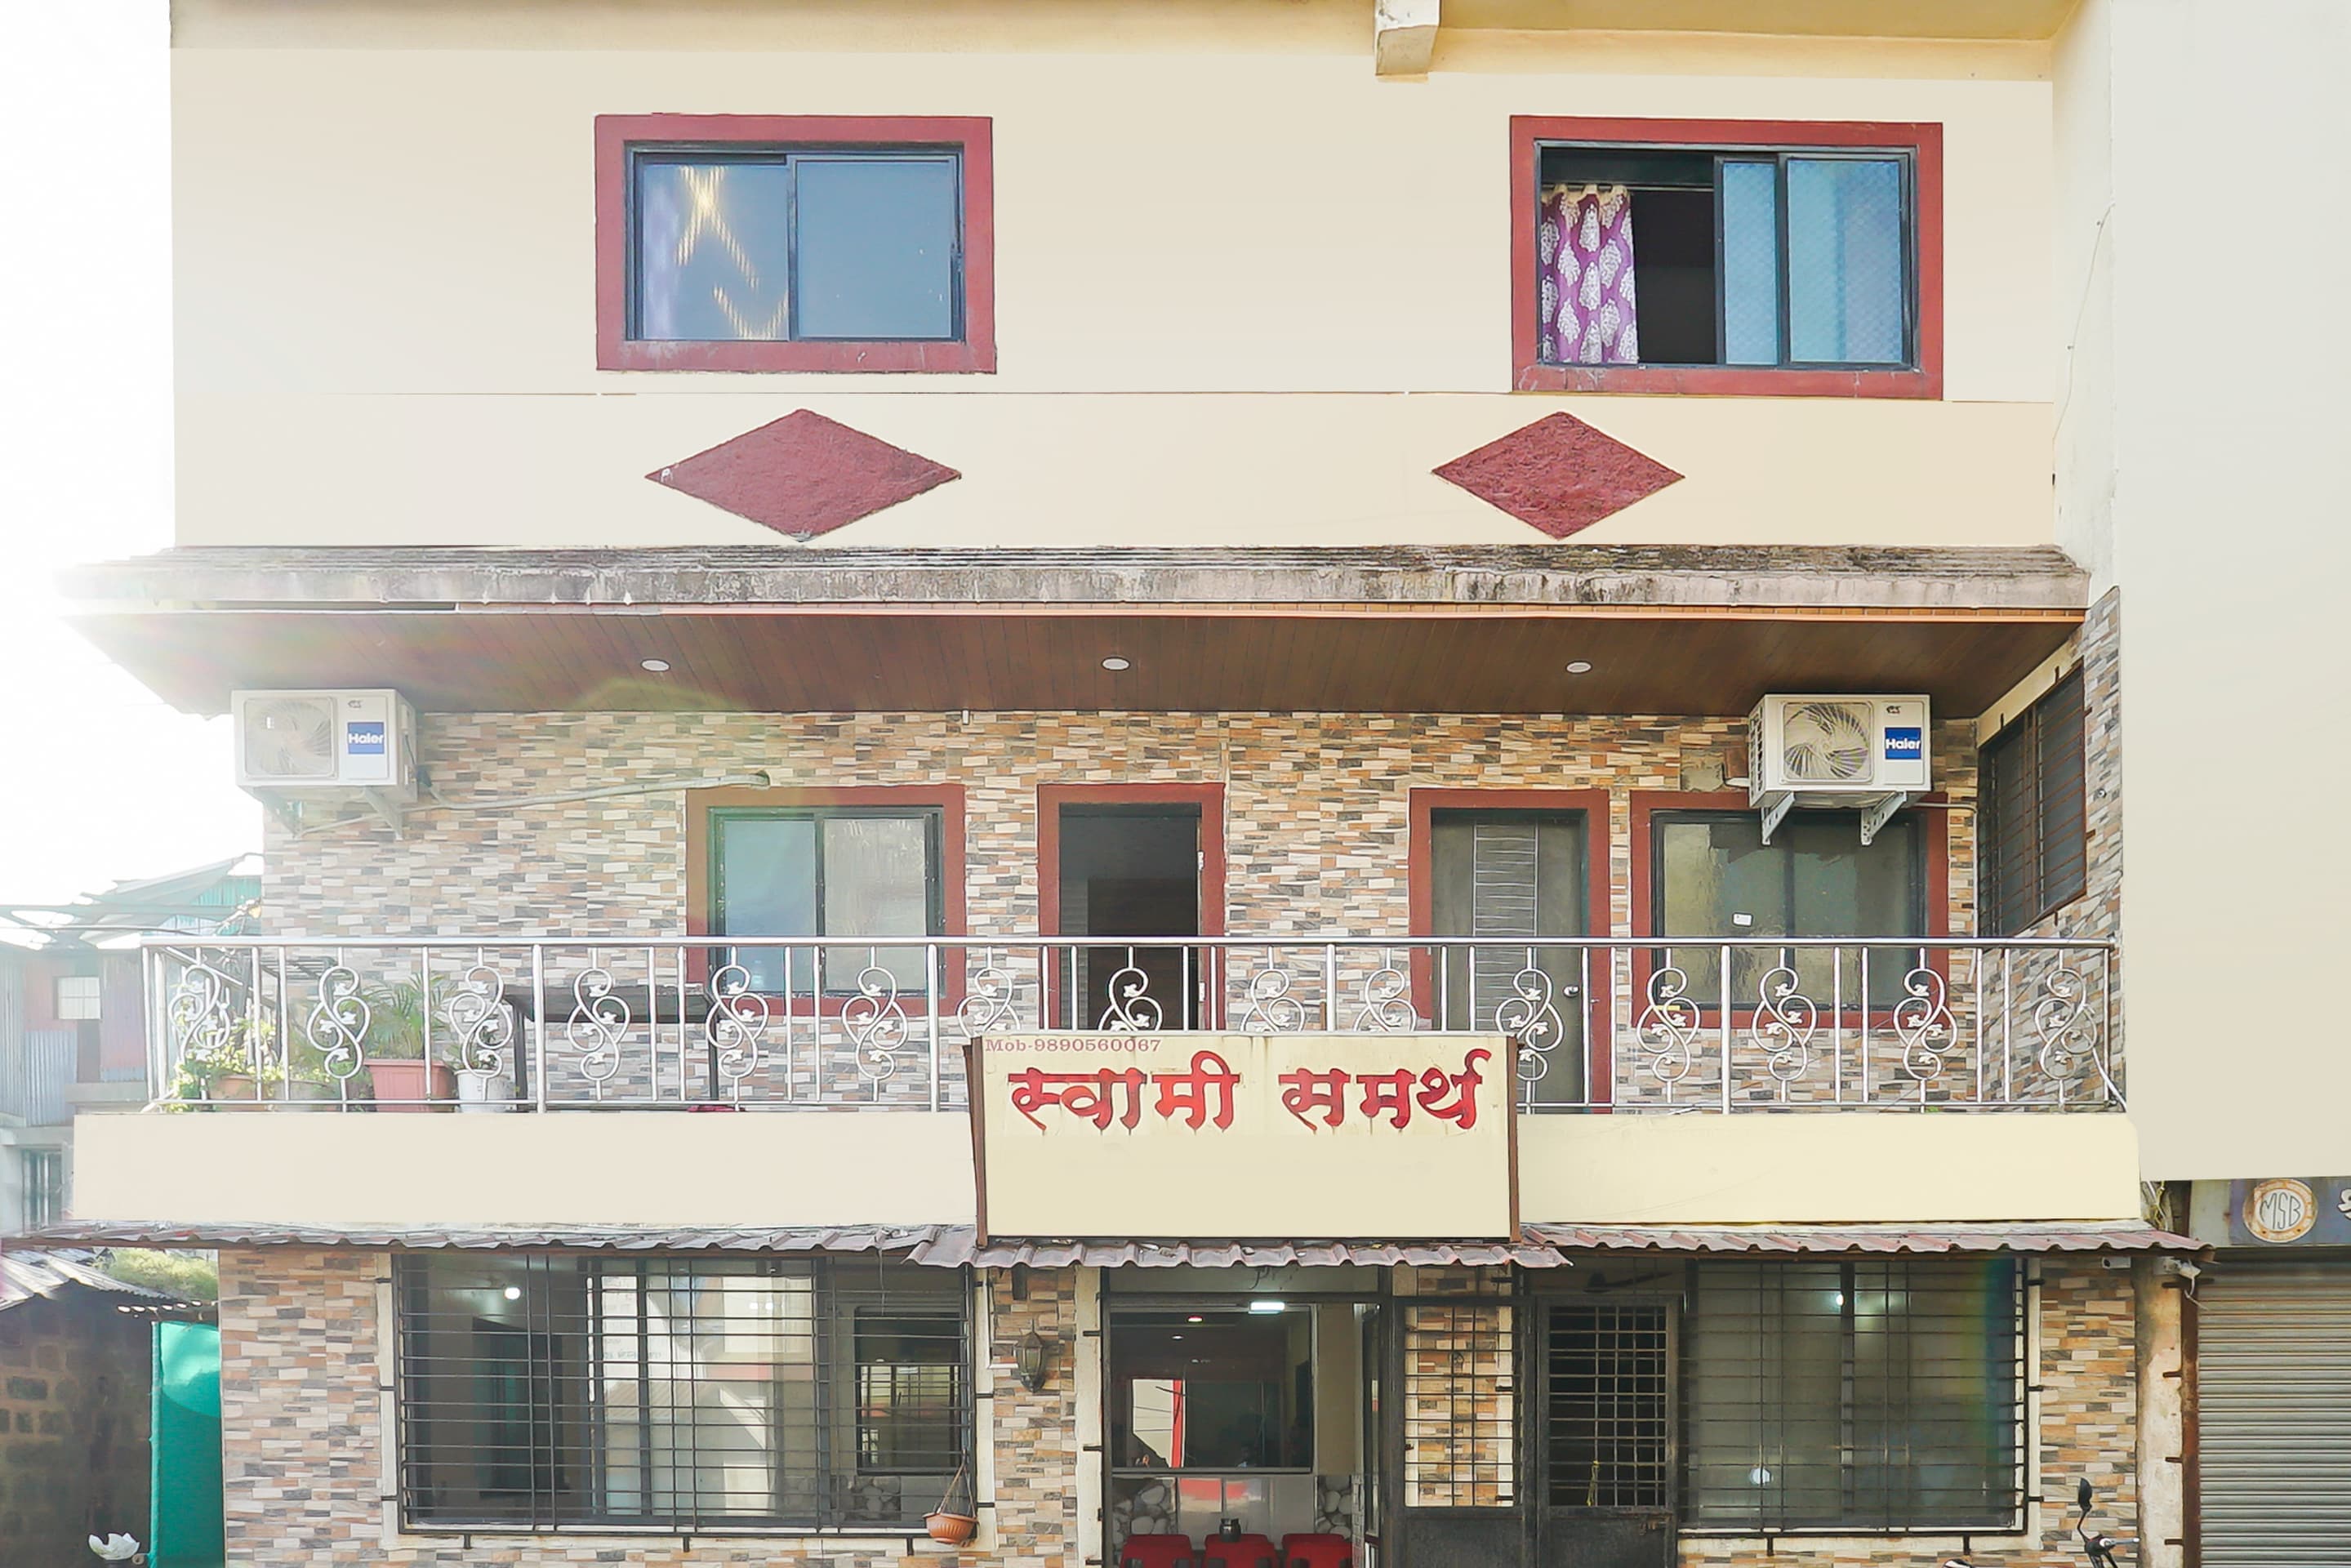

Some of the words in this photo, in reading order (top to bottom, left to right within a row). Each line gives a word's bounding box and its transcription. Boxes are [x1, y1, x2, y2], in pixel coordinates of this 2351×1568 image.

[349, 733, 384, 745] Haier
[1886, 737, 1921, 750] Haier
[985, 1038, 1161, 1053] Mob-9890560067
[1009, 1049, 1240, 1131] स्वामी
[1279, 1048, 1492, 1131] समर्थ
[2259, 1192, 2302, 1230] MSB
